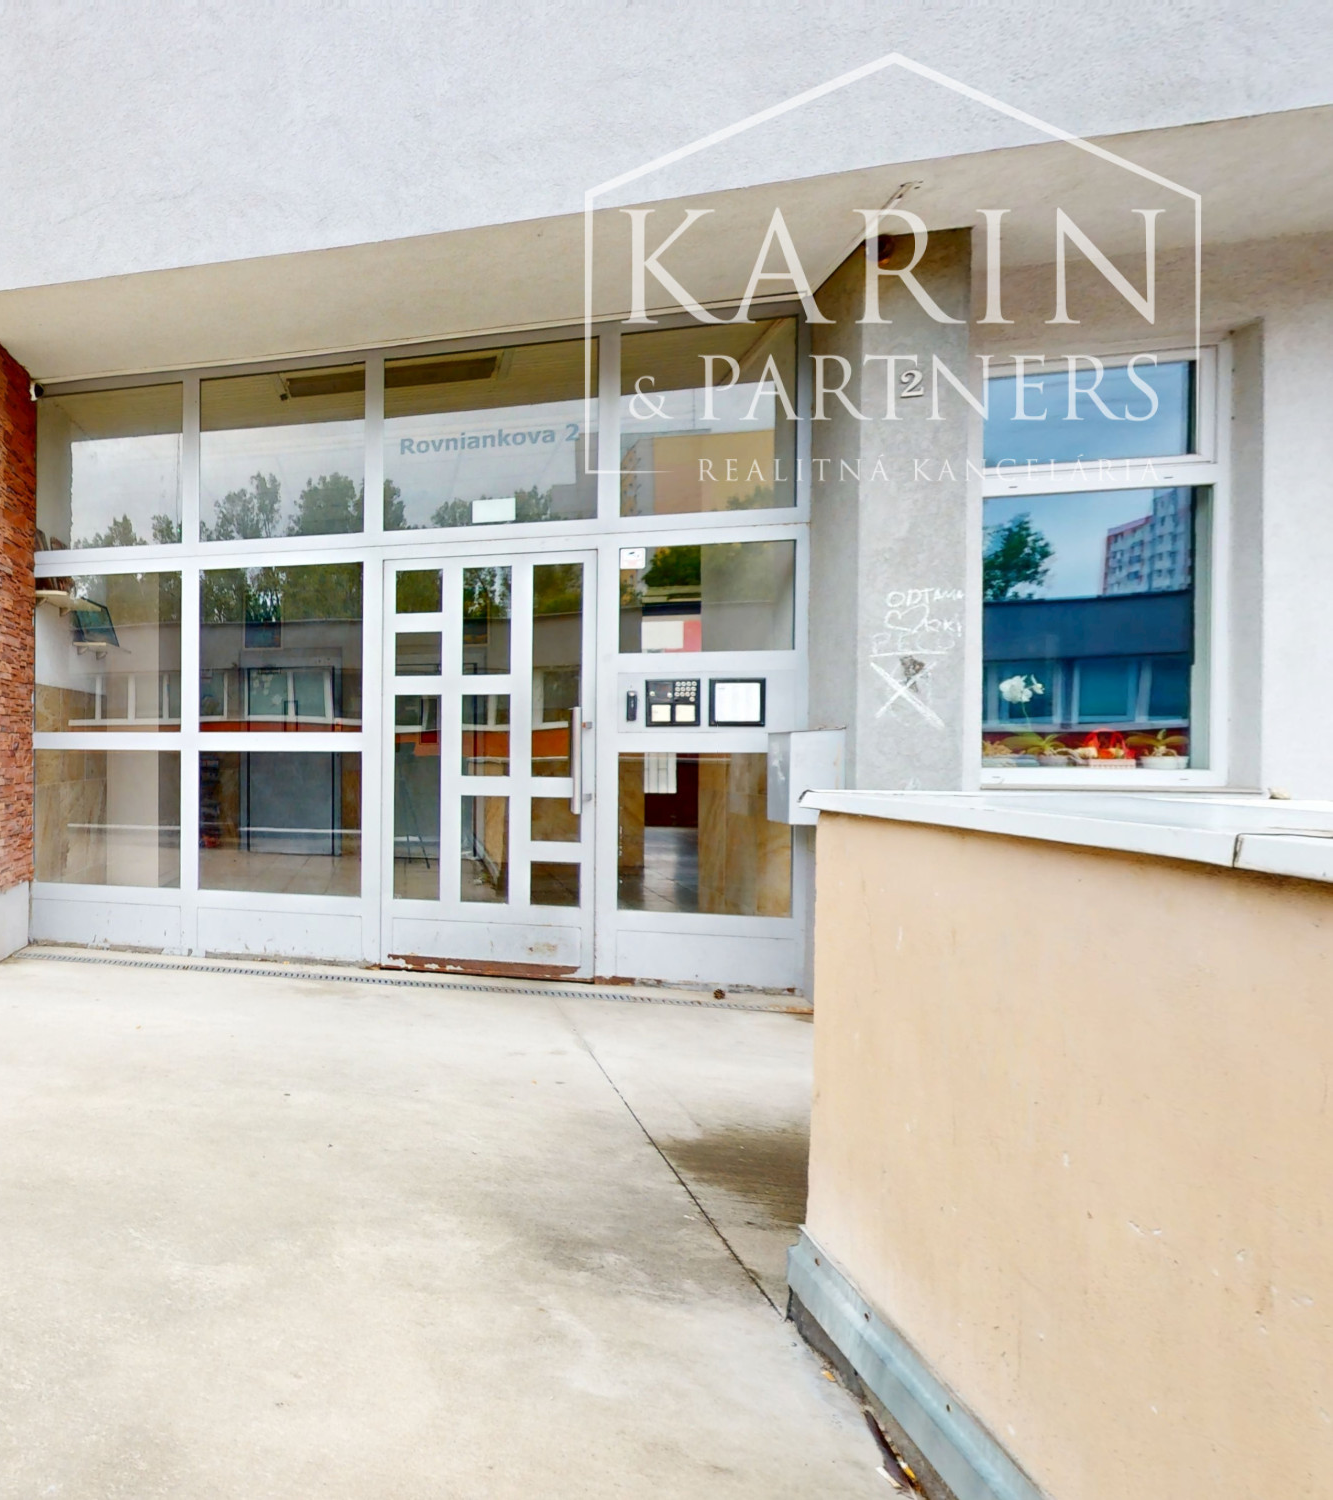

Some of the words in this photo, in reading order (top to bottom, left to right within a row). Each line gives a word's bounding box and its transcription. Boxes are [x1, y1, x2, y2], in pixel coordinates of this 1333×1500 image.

[900, 369, 925, 398] 2
[400, 428, 556, 455] Rovniankova
[565, 423, 580, 442] 2
